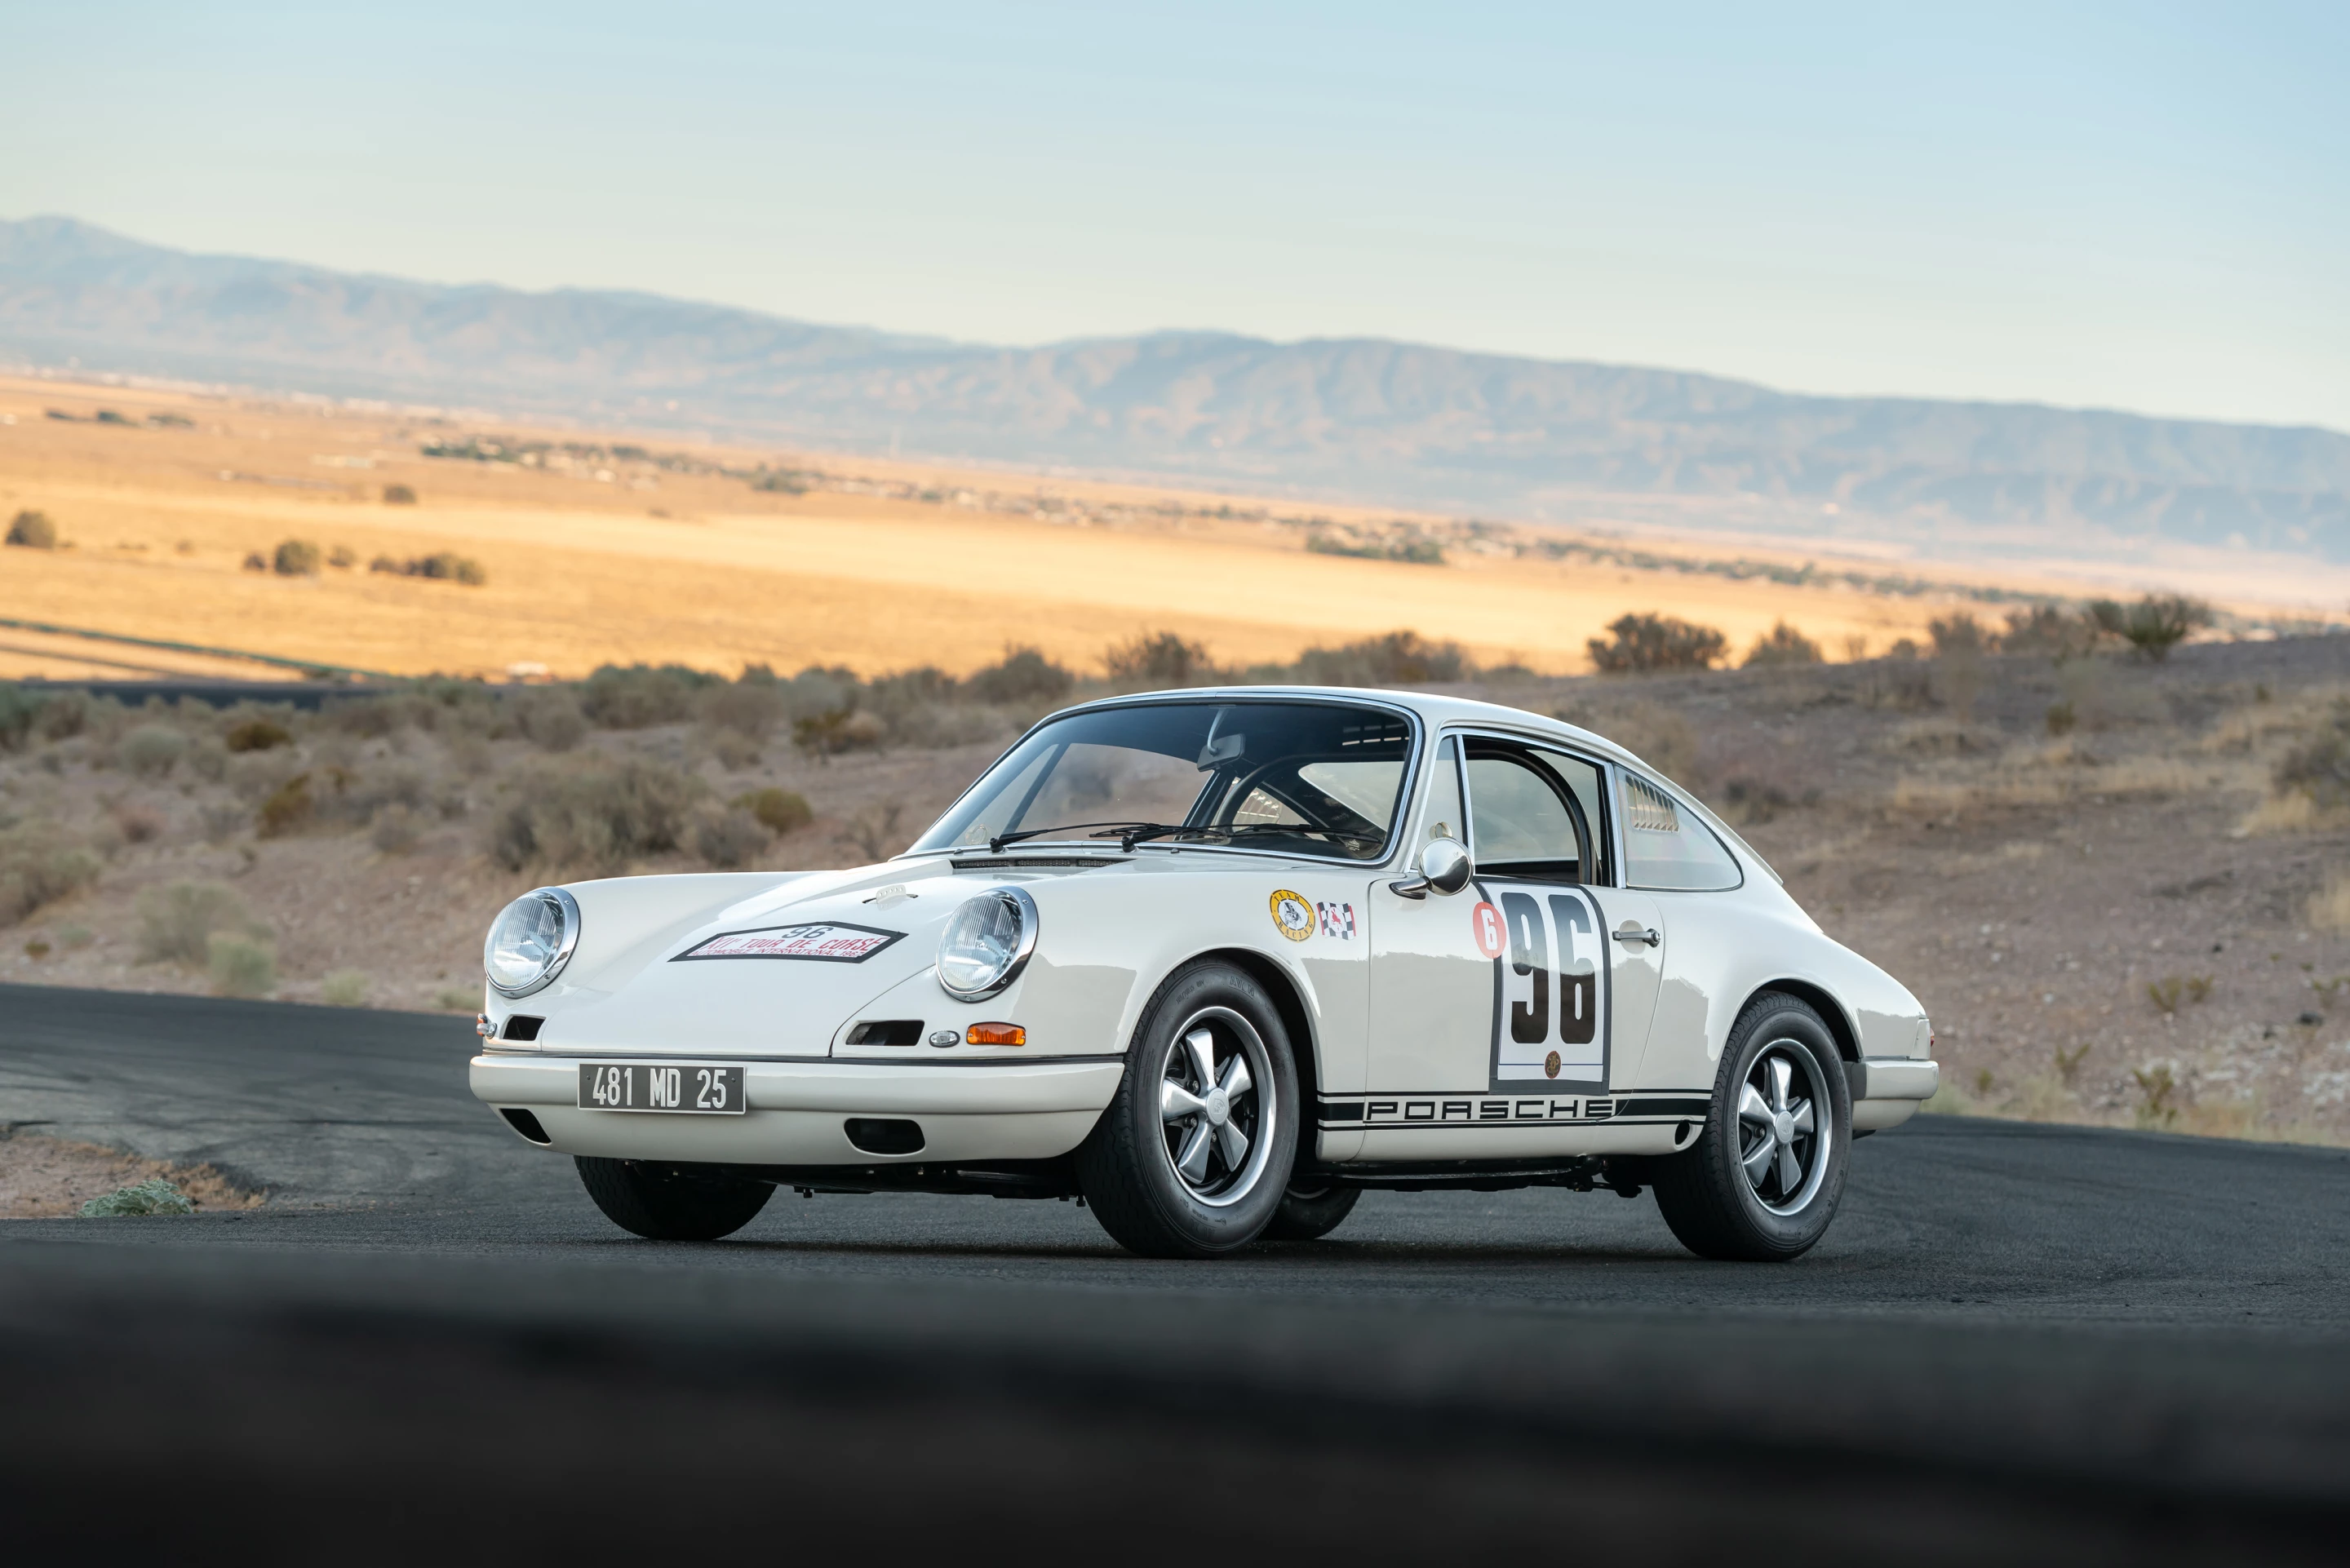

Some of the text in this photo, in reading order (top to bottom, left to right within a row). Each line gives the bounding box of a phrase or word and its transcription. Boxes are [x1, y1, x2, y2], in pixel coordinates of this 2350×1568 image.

[1274, 892, 1300, 902] TEAM
[781, 927, 834, 939] 96
[1279, 921, 1313, 939] RACING
[1480, 908, 1498, 950] 6
[739, 938, 785, 949] TOUR
[786, 939, 818, 949] DE
[818, 937, 891, 951] CORSE
[753, 948, 837, 956] INTERNATIONAL
[1500, 892, 1596, 1045] 96
[592, 1067, 727, 1109] 481 MD 25
[1366, 1099, 1613, 1120] PORSCHE
